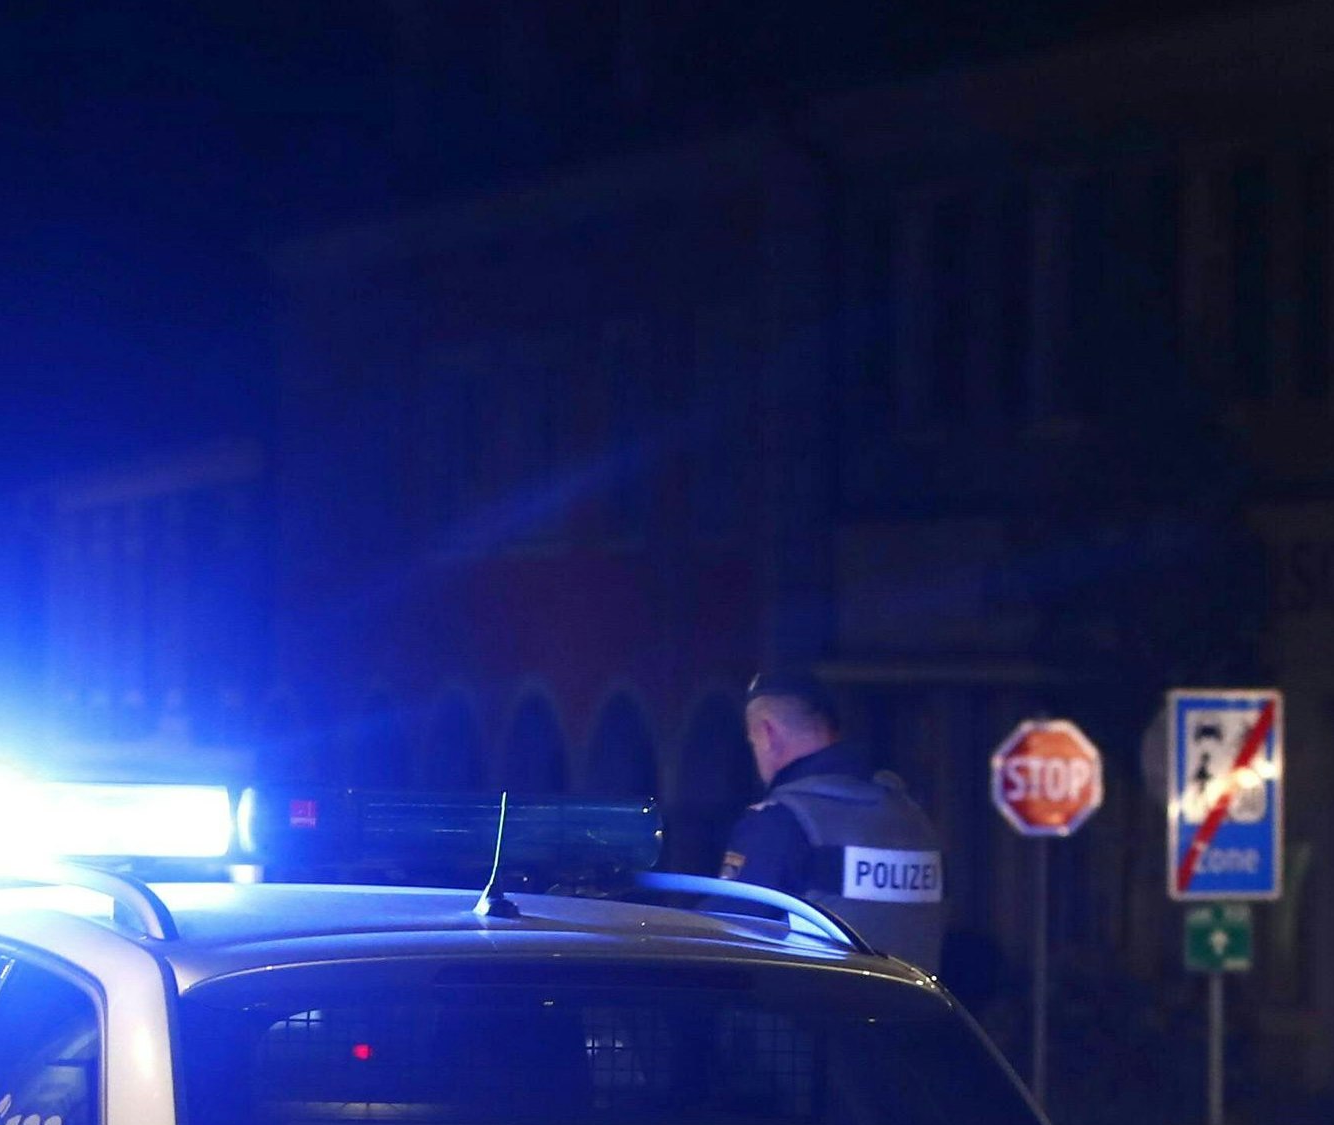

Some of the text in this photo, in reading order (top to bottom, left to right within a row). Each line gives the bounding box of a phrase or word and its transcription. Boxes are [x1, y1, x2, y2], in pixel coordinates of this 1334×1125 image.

[1005, 757, 1091, 801] STOP
[1192, 841, 1260, 874] Zone
[856, 861, 937, 891] POLIZEI
